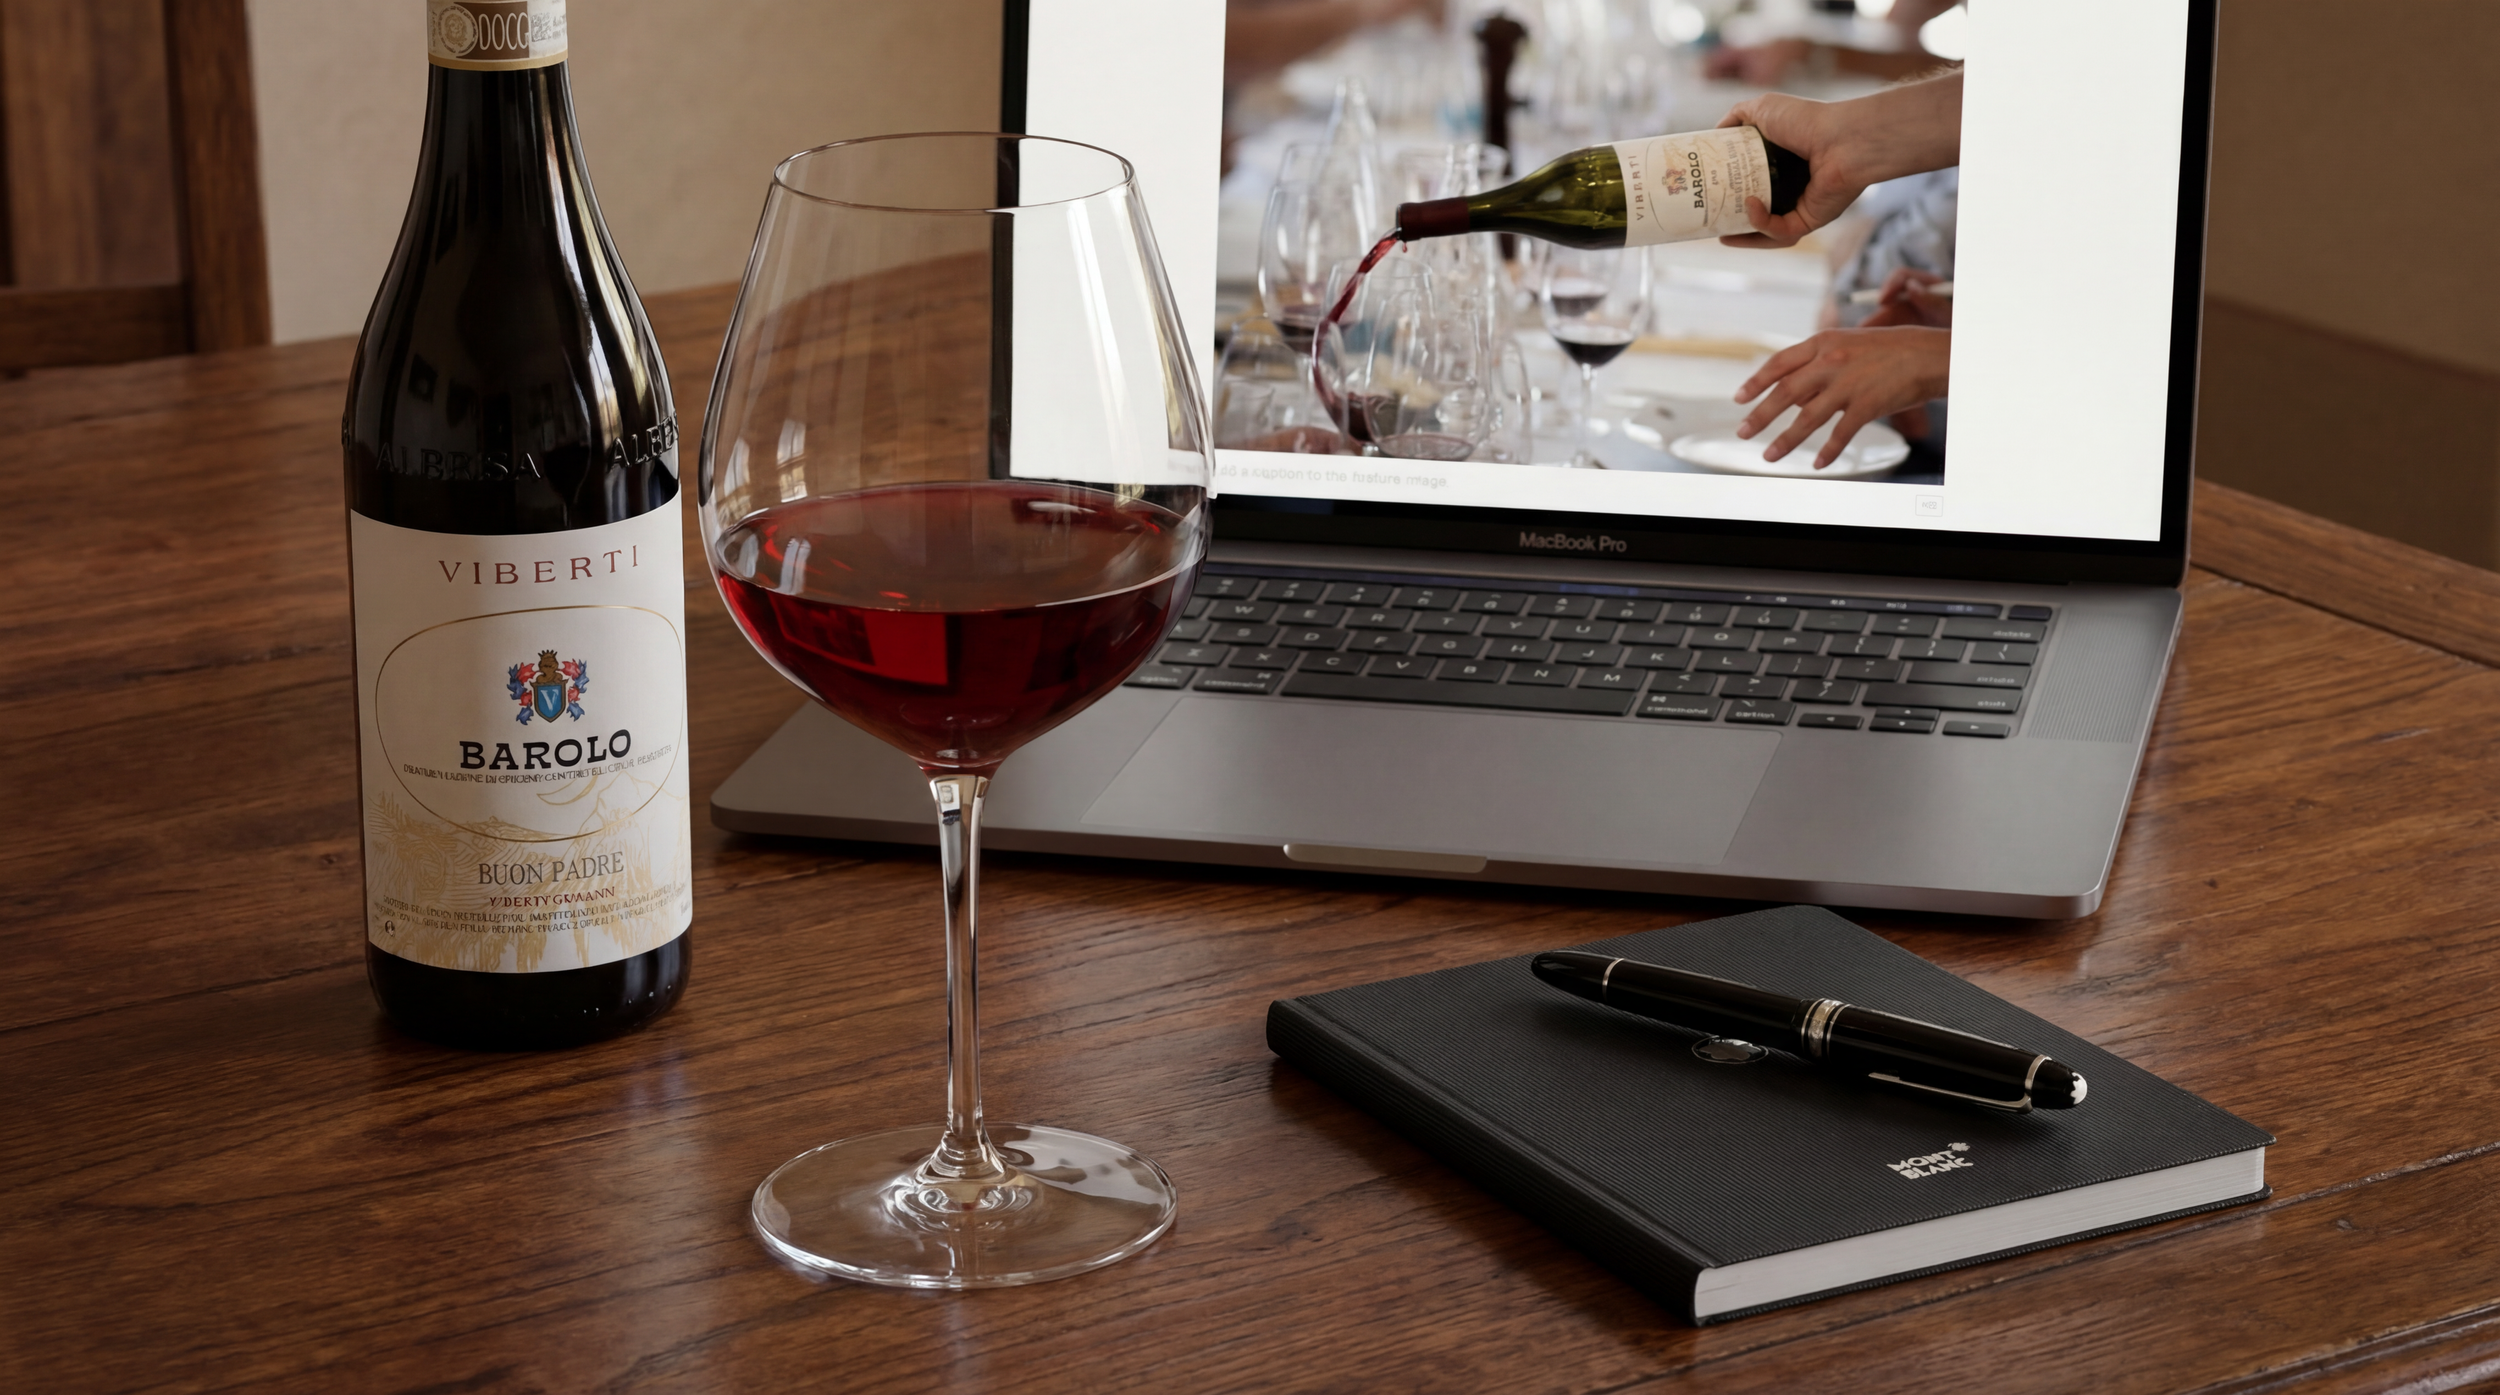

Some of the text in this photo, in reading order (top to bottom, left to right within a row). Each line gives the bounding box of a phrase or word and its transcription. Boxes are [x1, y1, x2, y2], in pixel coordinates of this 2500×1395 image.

[478, 12, 530, 50] DOCG
[1688, 151, 1705, 209] BAROLO
[1307, 469, 1322, 481] to
[1325, 470, 1348, 483] the
[1519, 531, 1628, 553] MacBook Pro
[438, 544, 639, 585] VIBERTI
[459, 729, 632, 770] BAROLO
[478, 851, 625, 886] BUON PADRE
[1886, 1150, 1956, 1172] MONT
[1899, 1157, 1974, 1180] BLANC
